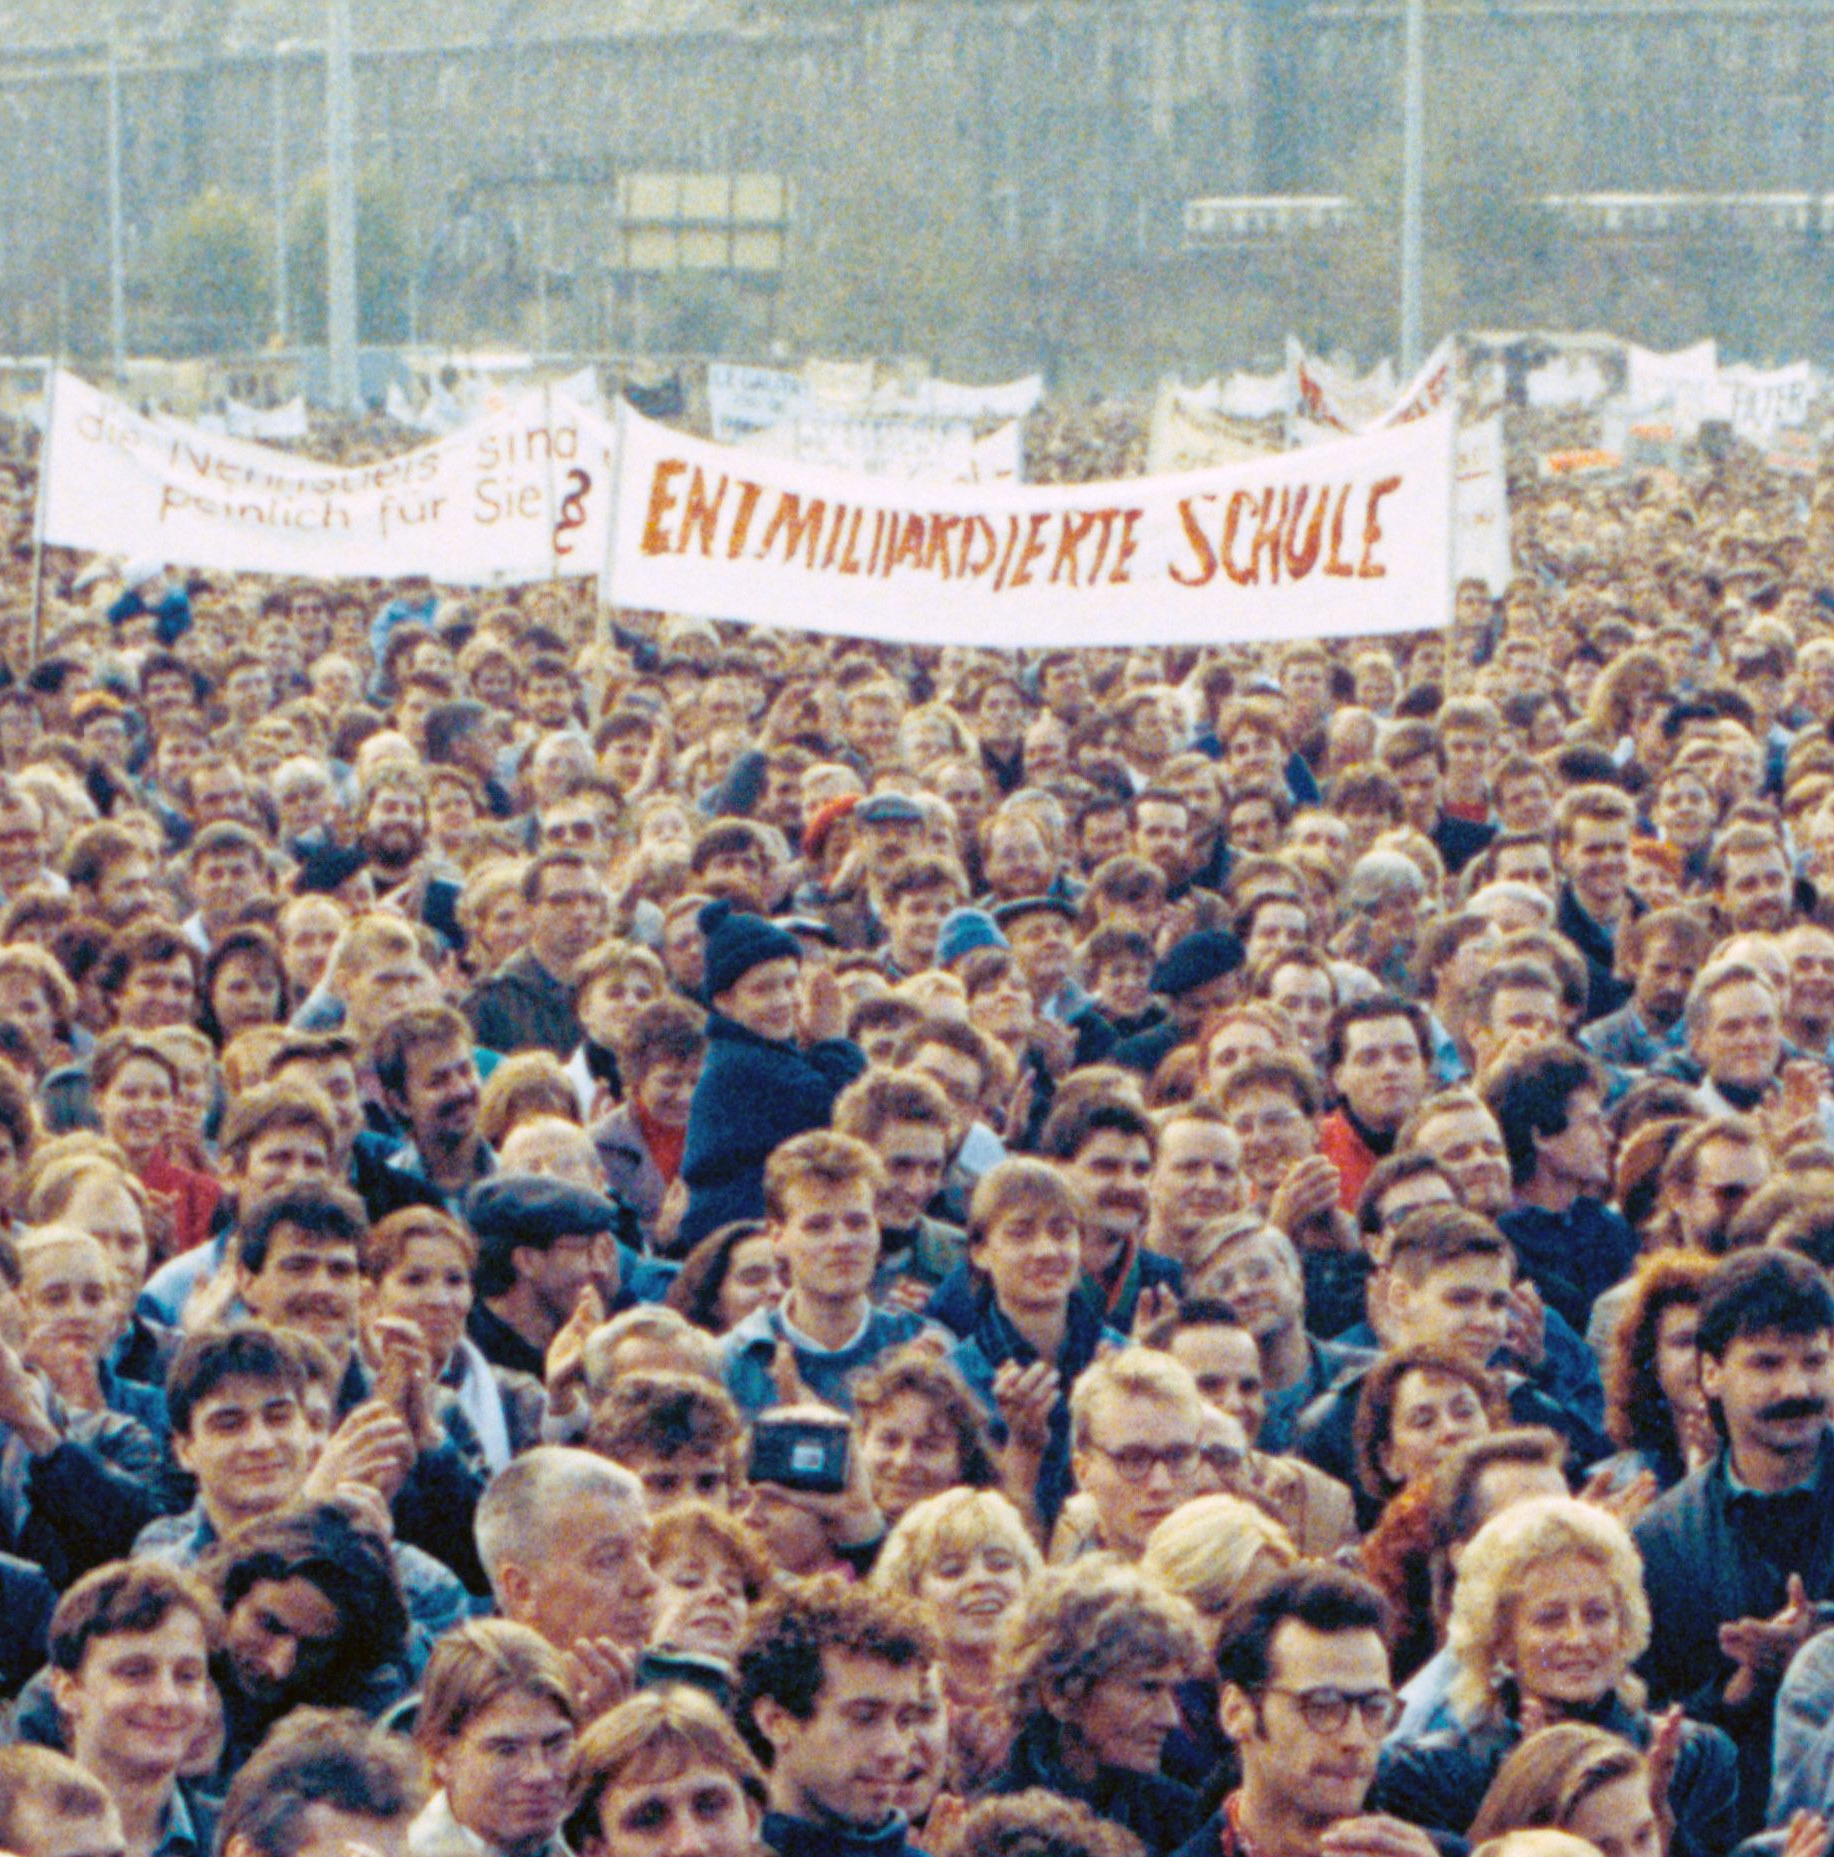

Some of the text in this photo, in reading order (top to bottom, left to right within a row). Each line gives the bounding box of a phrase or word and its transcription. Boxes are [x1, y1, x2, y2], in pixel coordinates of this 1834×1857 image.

[475, 424, 579, 471] sind
[158, 485, 352, 533] peinlich
[377, 494, 448, 540] für
[1167, 475, 1402, 588] SCHULE
